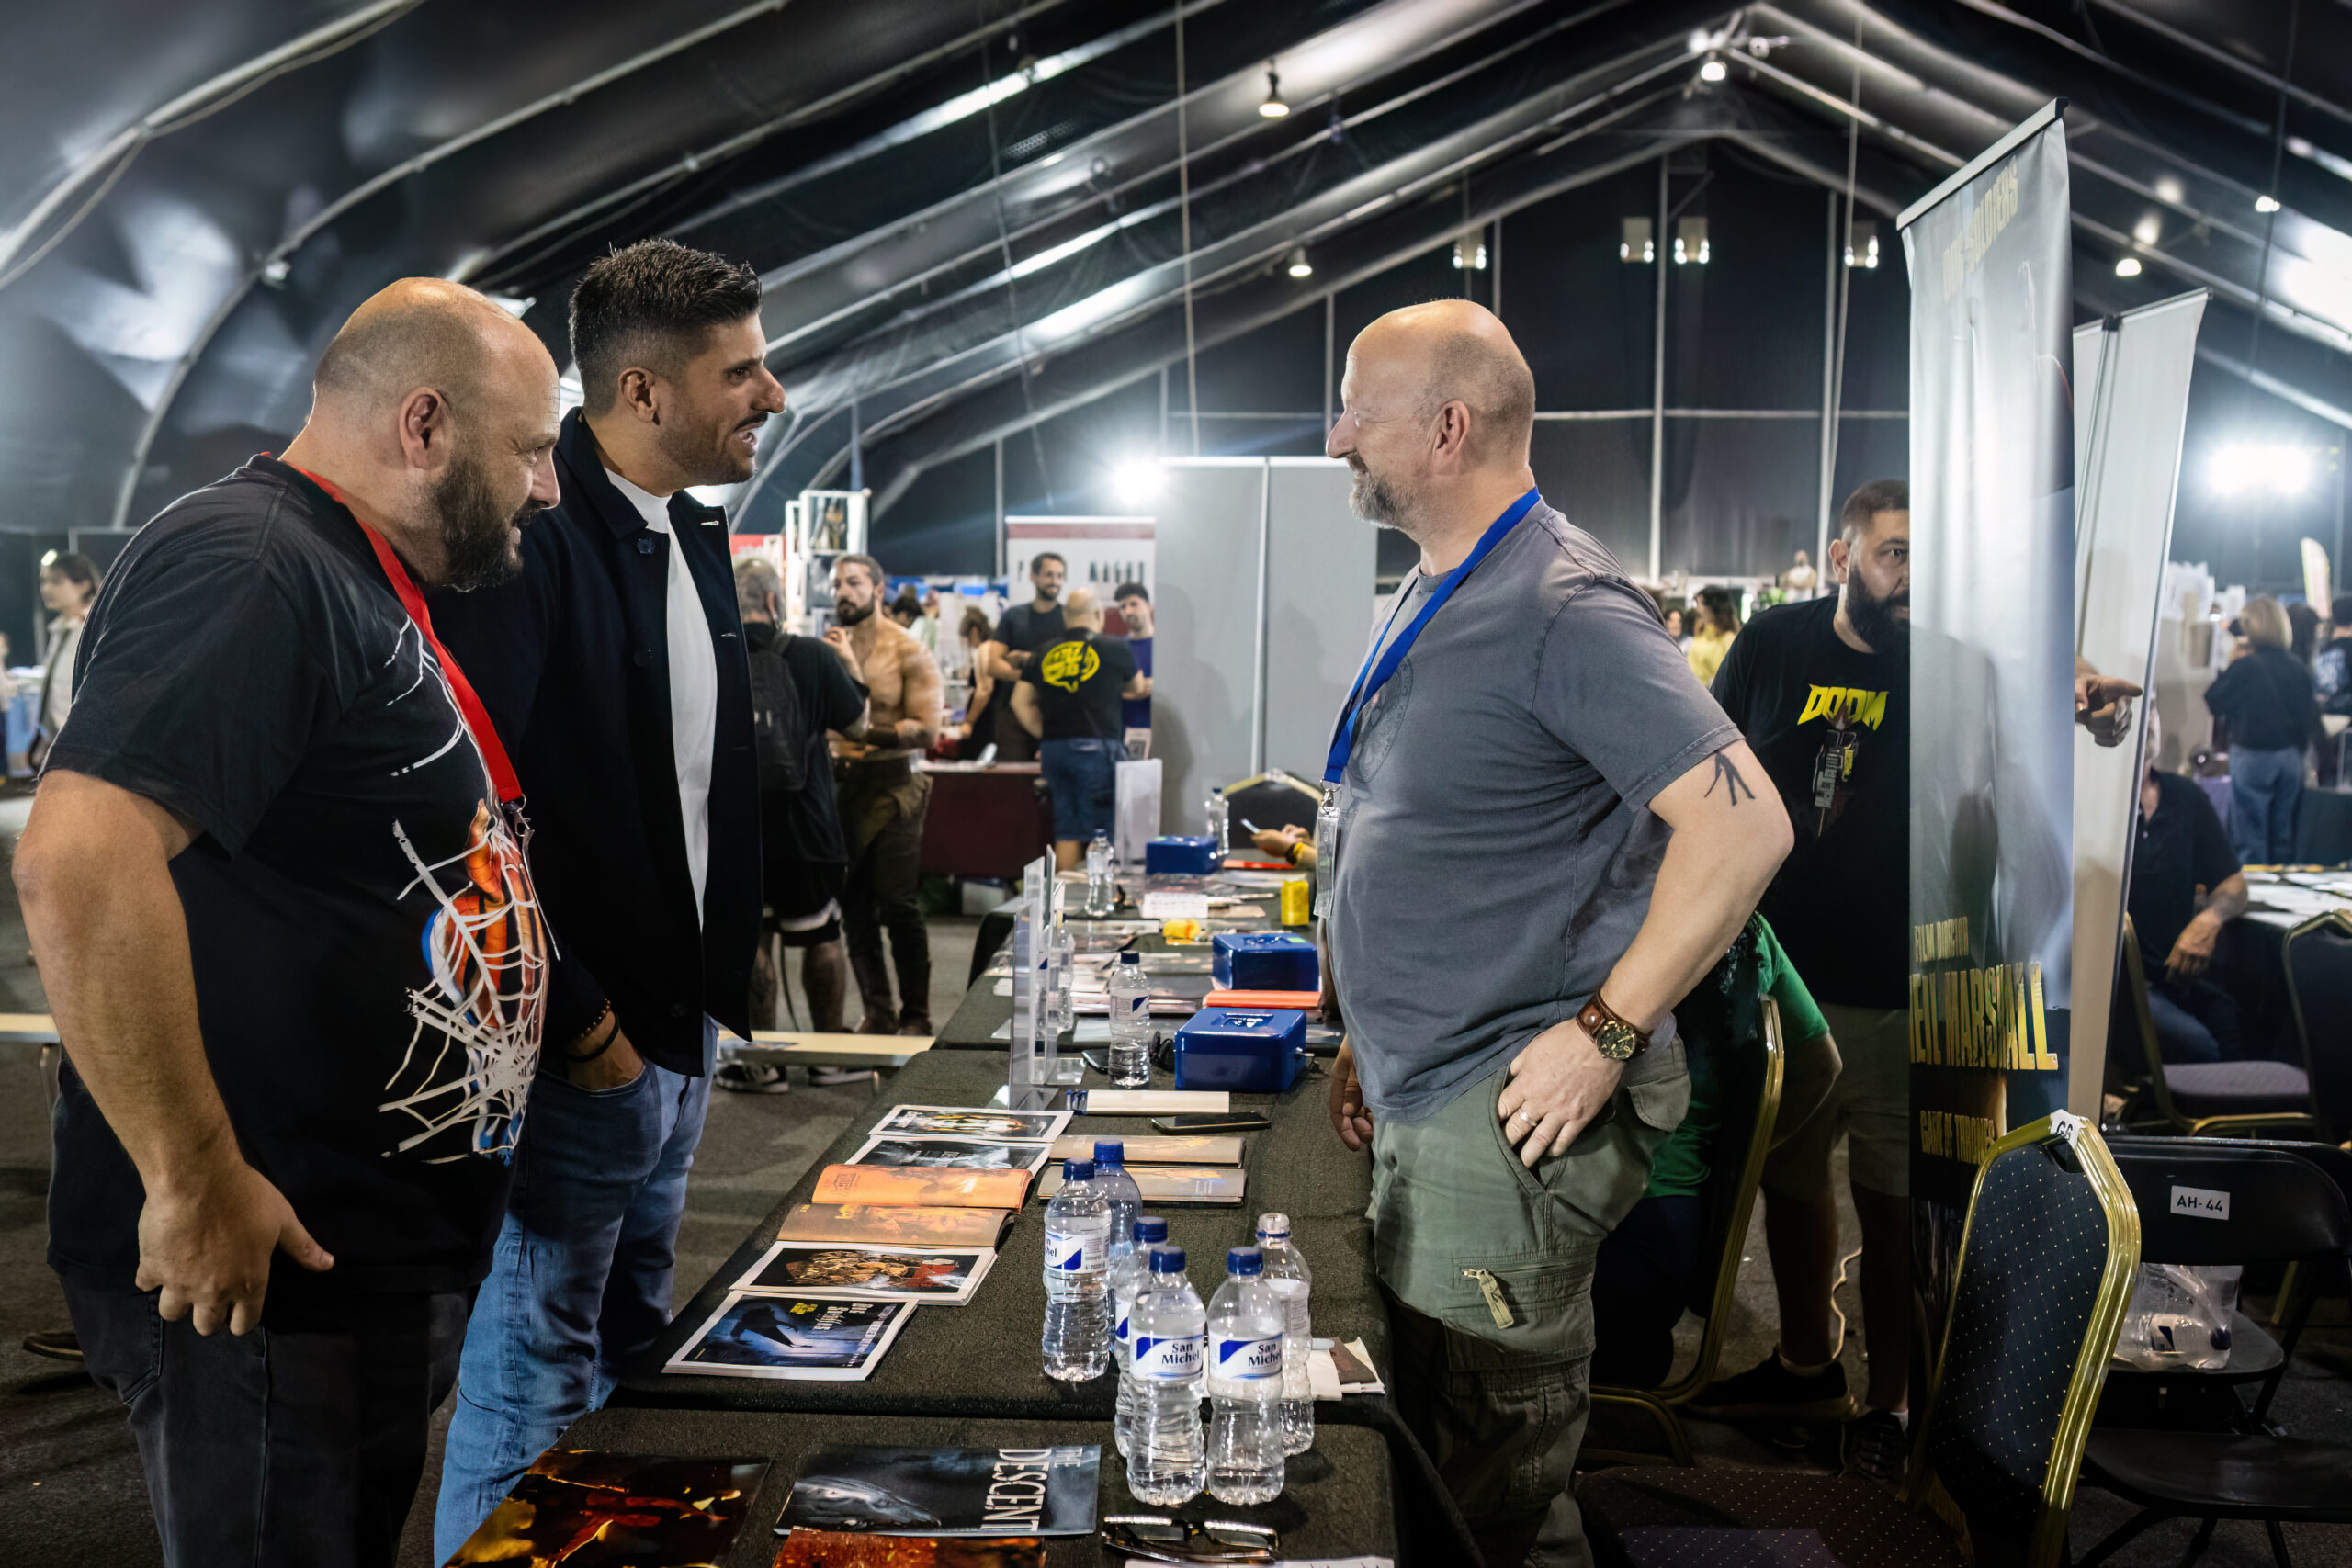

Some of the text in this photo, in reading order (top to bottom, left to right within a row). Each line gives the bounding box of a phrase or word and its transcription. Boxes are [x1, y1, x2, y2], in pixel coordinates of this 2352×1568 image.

[1797, 683, 1889, 731] DOOM
[1909, 962, 2059, 1071] EIL MARSHALL
[2177, 1195, 2223, 1212] AH-44
[1161, 1348, 1200, 1365] Michel
[1171, 1342, 1193, 1353] San
[1258, 1343, 1277, 1355] San
[1053, 1447, 1083, 1469] THE
[979, 1448, 1053, 1532] DESCENT
